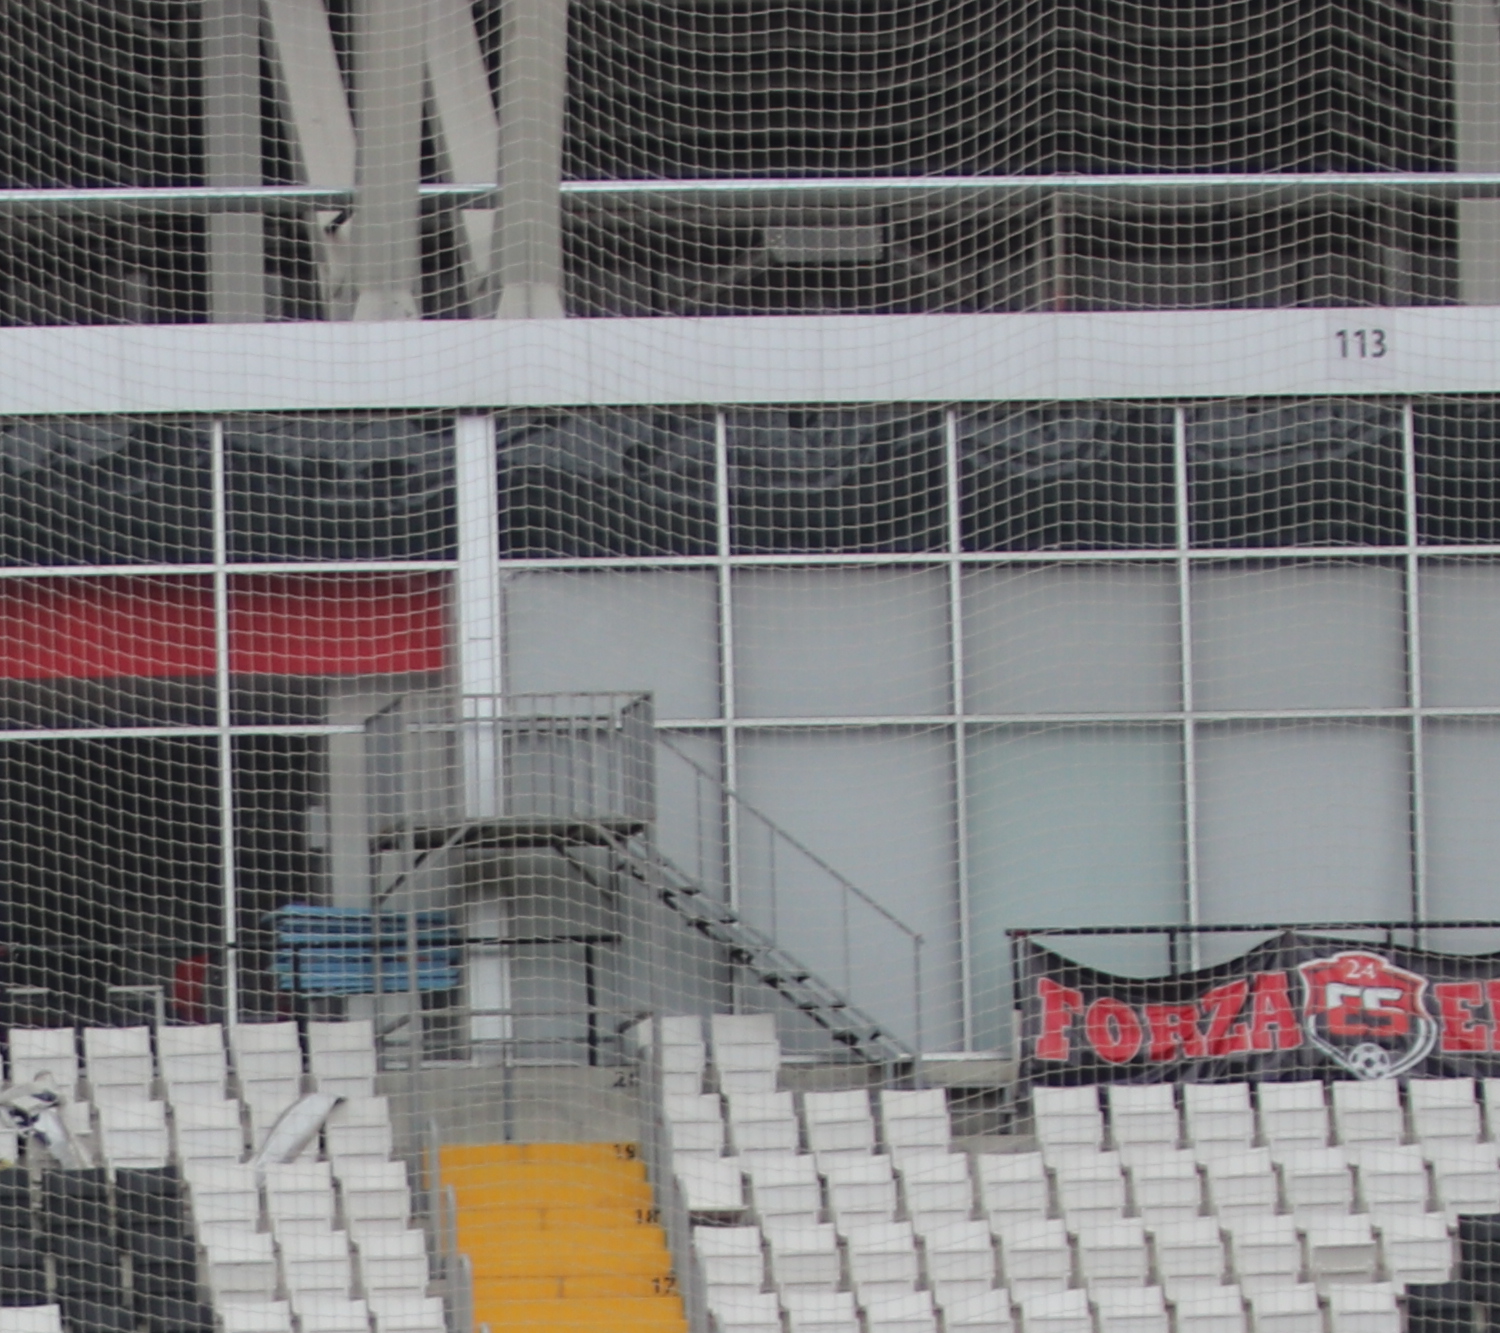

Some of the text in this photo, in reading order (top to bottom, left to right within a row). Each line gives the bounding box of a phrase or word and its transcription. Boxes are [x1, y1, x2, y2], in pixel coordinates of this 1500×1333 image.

[1335, 328, 1388, 358] 113
[1346, 959, 1377, 979] 24
[1035, 970, 1302, 1064] FORZA
[652, 1277, 677, 1295] 17
